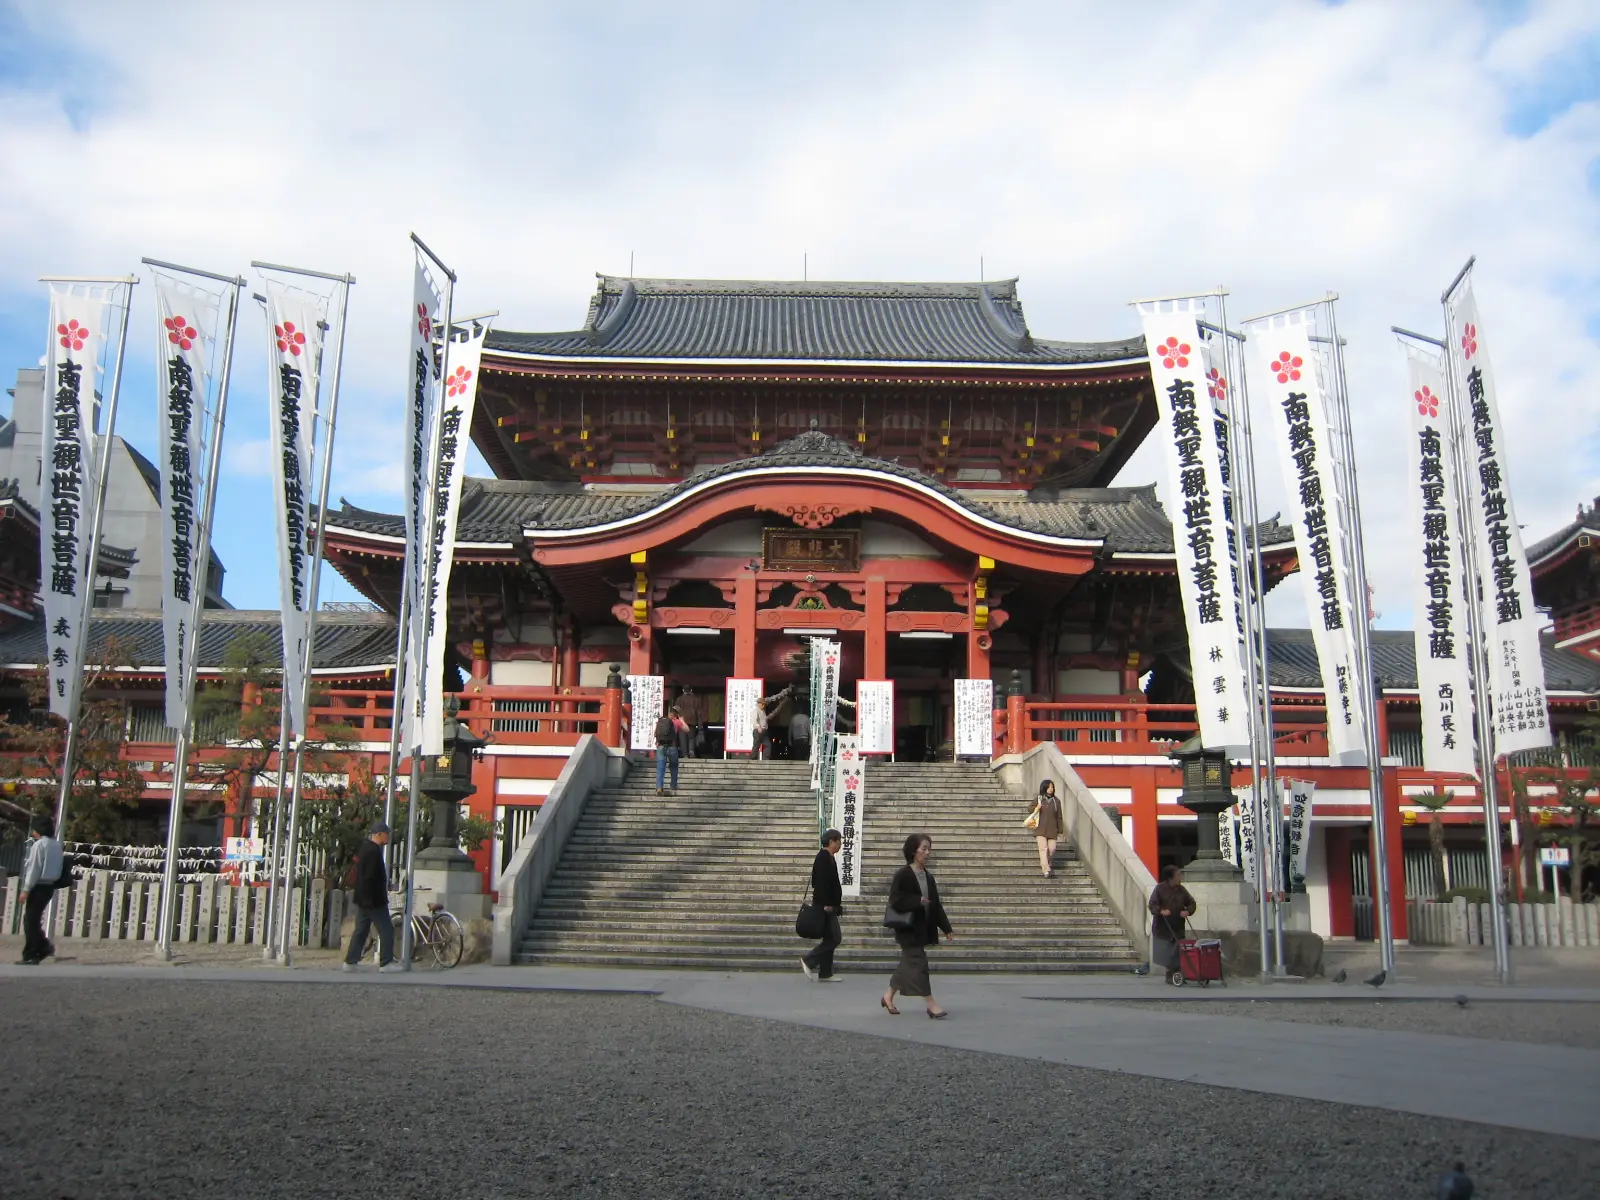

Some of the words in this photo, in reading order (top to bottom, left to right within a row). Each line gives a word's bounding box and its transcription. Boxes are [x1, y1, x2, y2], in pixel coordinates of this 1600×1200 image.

[51, 358, 82, 597] 南無聖観世音菩薩
[168, 355, 193, 604] 南無聖観世音菩薩
[1166, 378, 1224, 624] 南無聖観世音菩薩
[1281, 392, 1344, 632] 南無聖観世音菩薩
[1417, 426, 1457, 659] 南無聖観世音菩薩
[1208, 645, 1229, 724] 林雲華
[1438, 683, 1456, 750] 西川長寿
[1218, 810, 1232, 860] 命地蔵尊
[1240, 799, 1254, 853] 大日如来
